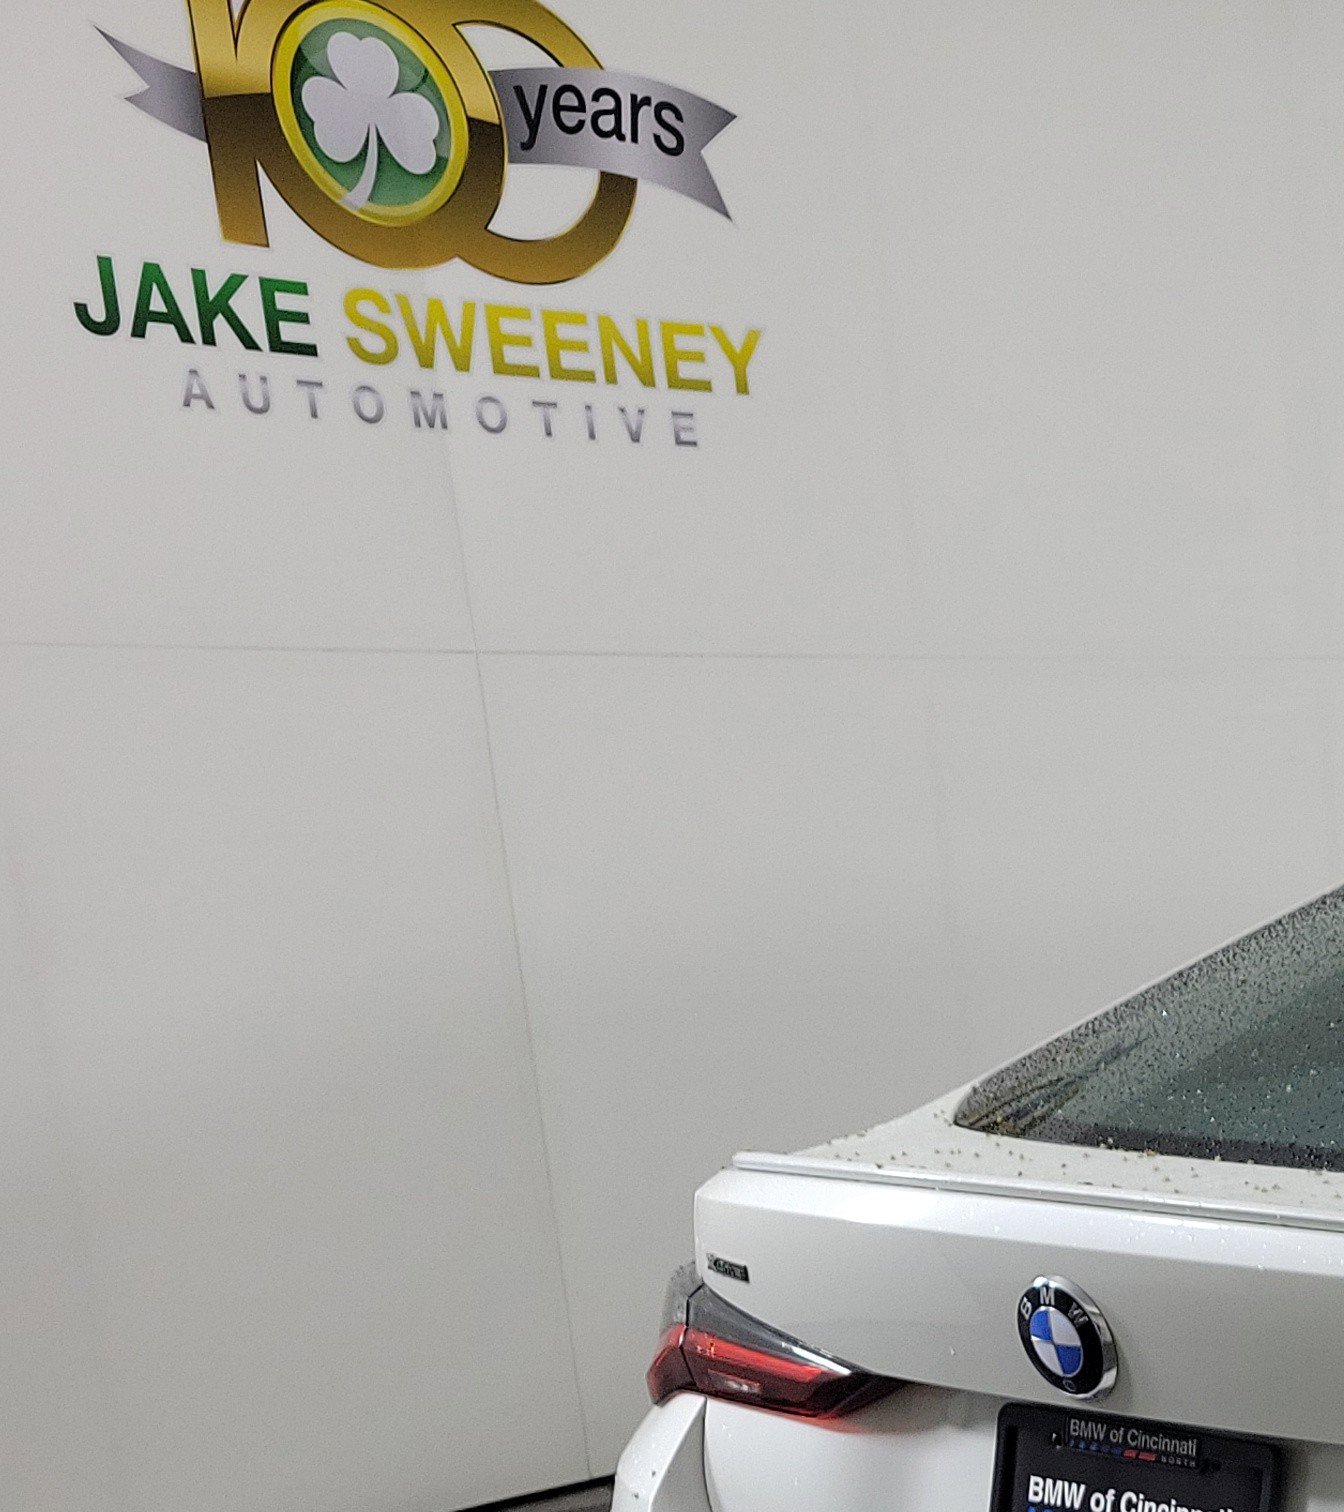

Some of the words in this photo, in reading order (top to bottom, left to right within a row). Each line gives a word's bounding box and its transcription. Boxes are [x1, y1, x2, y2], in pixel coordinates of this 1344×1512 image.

[513, 83, 685, 156] years
[73, 254, 318, 357] JAKE
[342, 287, 762, 395] SWEENEY
[182, 369, 698, 447] AUTOMOTIVE
[1020, 1285, 1089, 1326] BMW
[1069, 1418, 1106, 1441] BMW
[1110, 1427, 1124, 1443] of
[1127, 1428, 1197, 1457] Cincinnati
[1028, 1475, 1085, 1510] BMW
